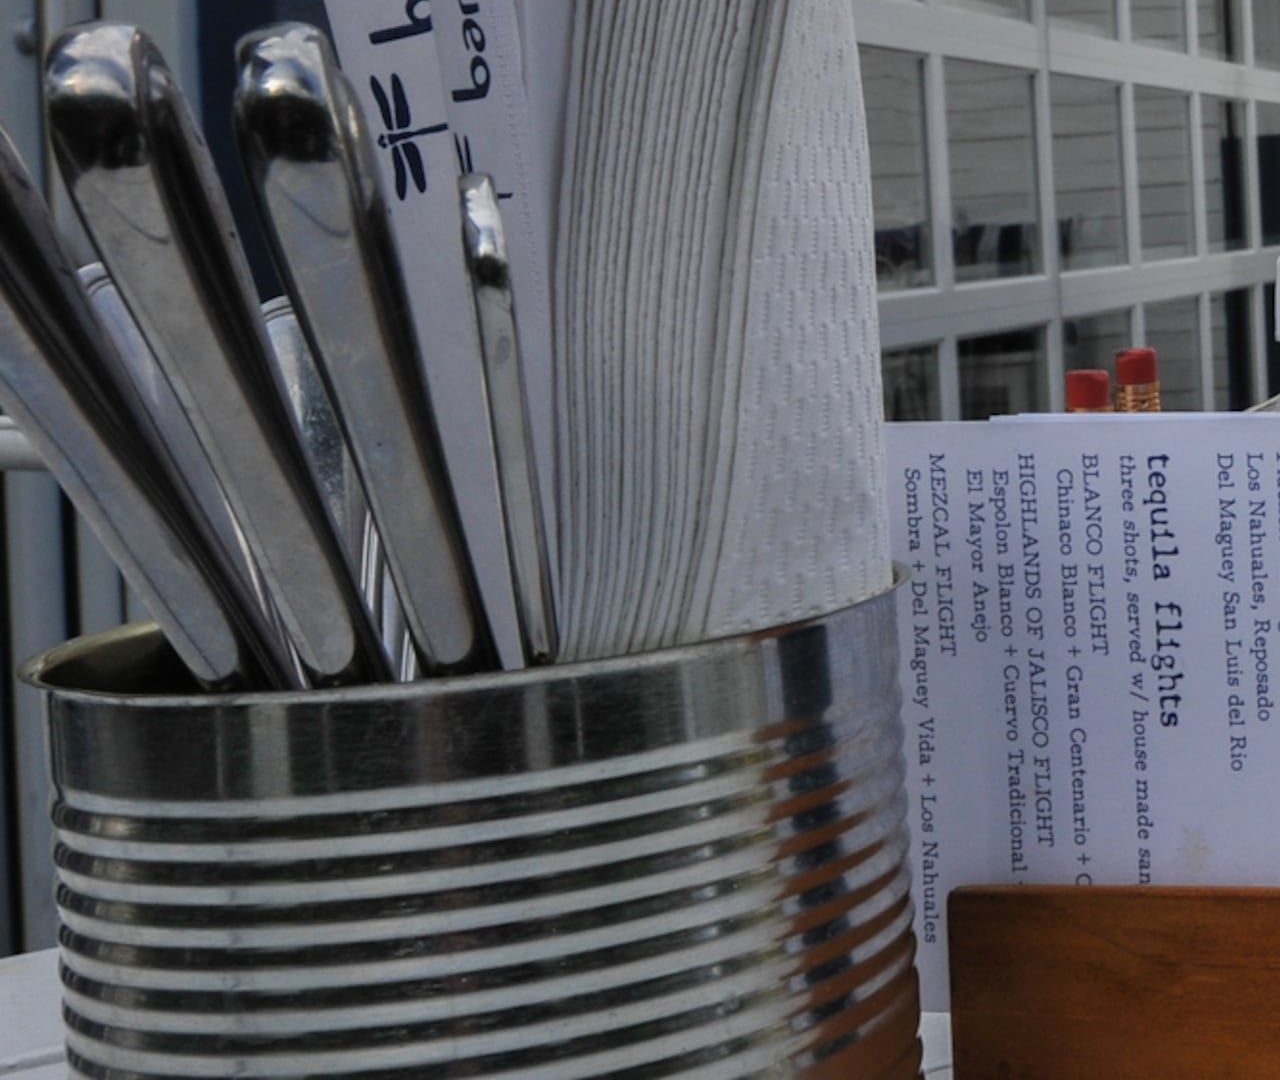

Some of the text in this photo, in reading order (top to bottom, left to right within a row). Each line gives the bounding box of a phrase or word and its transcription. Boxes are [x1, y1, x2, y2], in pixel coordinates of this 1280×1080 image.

[905, 468, 923, 552] Sombra
[989, 470, 1011, 555] Espolon
[1057, 469, 1074, 556] Chinaco
[1120, 456, 1136, 512] three
[929, 454, 956, 656] MEZCAL FLIGHT
[966, 470, 991, 642] El Mayor Anejo
[1082, 454, 1109, 656] BLANCO FLIGHT
[1123, 520, 1139, 583] shots,
[1143, 454, 1183, 727] tequila flights
[1247, 453, 1273, 721] Los Nahuales, Reposado
[912, 581, 928, 616] Del
[998, 564, 1014, 637] Blanco
[1061, 564, 1078, 637] Blanco
[1127, 592, 1146, 663] served
[1215, 453, 1247, 771] Del Maguey San Luis del Rio
[910, 625, 930, 708] Maguey
[1018, 454, 1054, 847] HIGHLANDS OF JALISCO FLIGHT
[1066, 665, 1083, 719] Gran
[1130, 673, 1149, 701] w/
[919, 718, 935, 765] Vida
[1003, 665, 1020, 741] Cuervo
[1133, 710, 1149, 771] house
[921, 795, 936, 832] Los
[1008, 749, 1028, 873] Tradicional
[1070, 728, 1090, 845] Centenario
[1136, 780, 1154, 840] made
[923, 842, 940, 943] Nahuales
